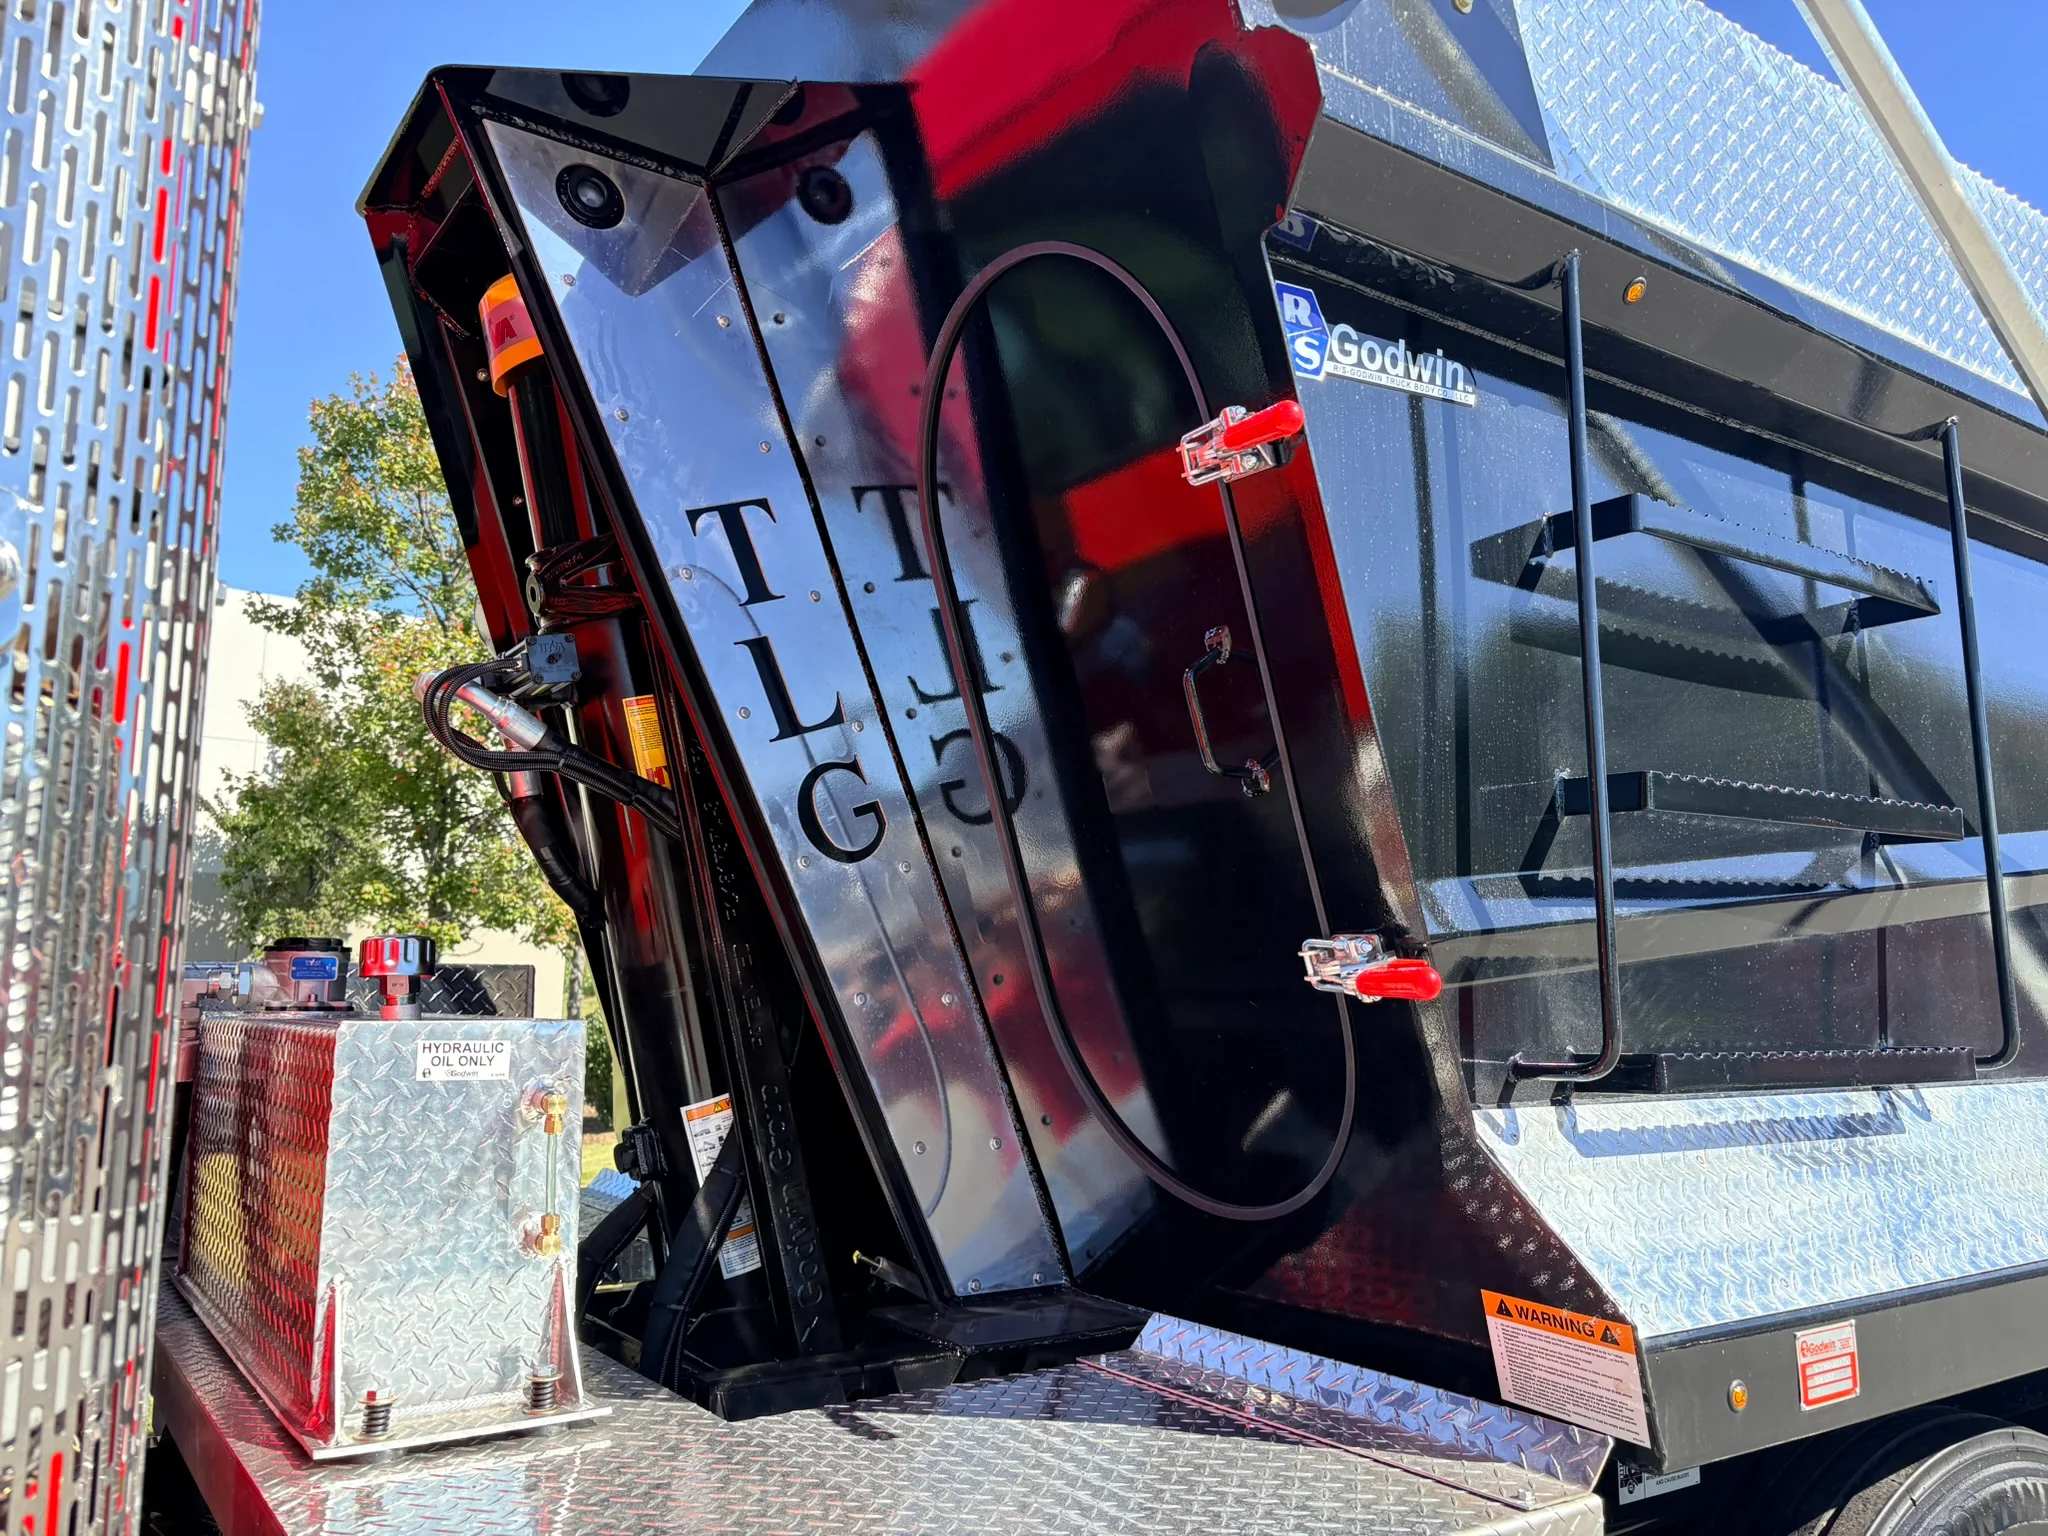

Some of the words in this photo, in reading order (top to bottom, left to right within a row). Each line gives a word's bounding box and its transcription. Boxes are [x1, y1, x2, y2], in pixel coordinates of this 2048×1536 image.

[1331, 323, 1465, 391] Godwin
[1385, 376, 1411, 389] TRUCK
[1414, 382, 1435, 394] BODY
[422, 1042, 504, 1054] HYDRAULIC
[431, 1055, 454, 1067] OIL
[458, 1055, 495, 1067] ONLY
[1514, 1304, 1595, 1338] WARNING
